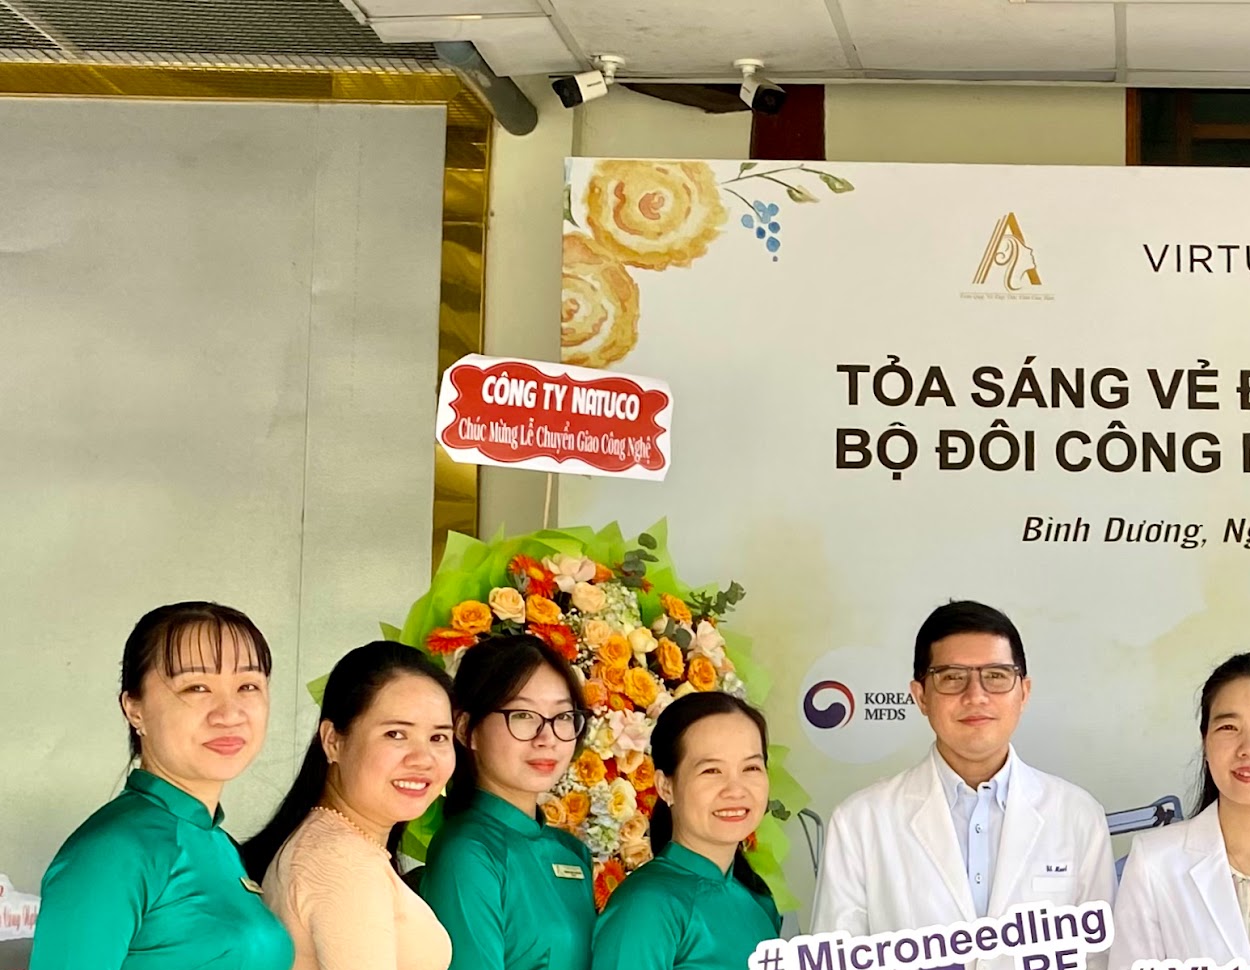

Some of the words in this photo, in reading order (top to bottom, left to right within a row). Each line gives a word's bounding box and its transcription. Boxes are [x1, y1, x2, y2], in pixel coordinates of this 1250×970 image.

[481, 371, 538, 409] CÔNG
[542, 382, 568, 412] TY
[571, 386, 640, 422] NATUCO
[836, 354, 957, 408] TỎA
[970, 355, 1130, 410] SÁNG
[1146, 358, 1221, 411] VẺ
[458, 415, 487, 443] Chúc
[488, 418, 519, 451] Mừng
[520, 417, 535, 447] Lễ
[536, 420, 575, 455] Chuyển
[576, 429, 600, 454] Giao
[600, 431, 626, 462] Công
[627, 435, 652, 465] Nghệ
[835, 421, 919, 481] BỘ
[935, 418, 1035, 472] ĐÔI
[1055, 420, 1222, 473] CÔNG
[1021, 516, 1091, 542] Bình
[1103, 517, 1208, 550] Dương,
[864, 692, 916, 705] KOREA
[864, 708, 906, 721] MFDS
